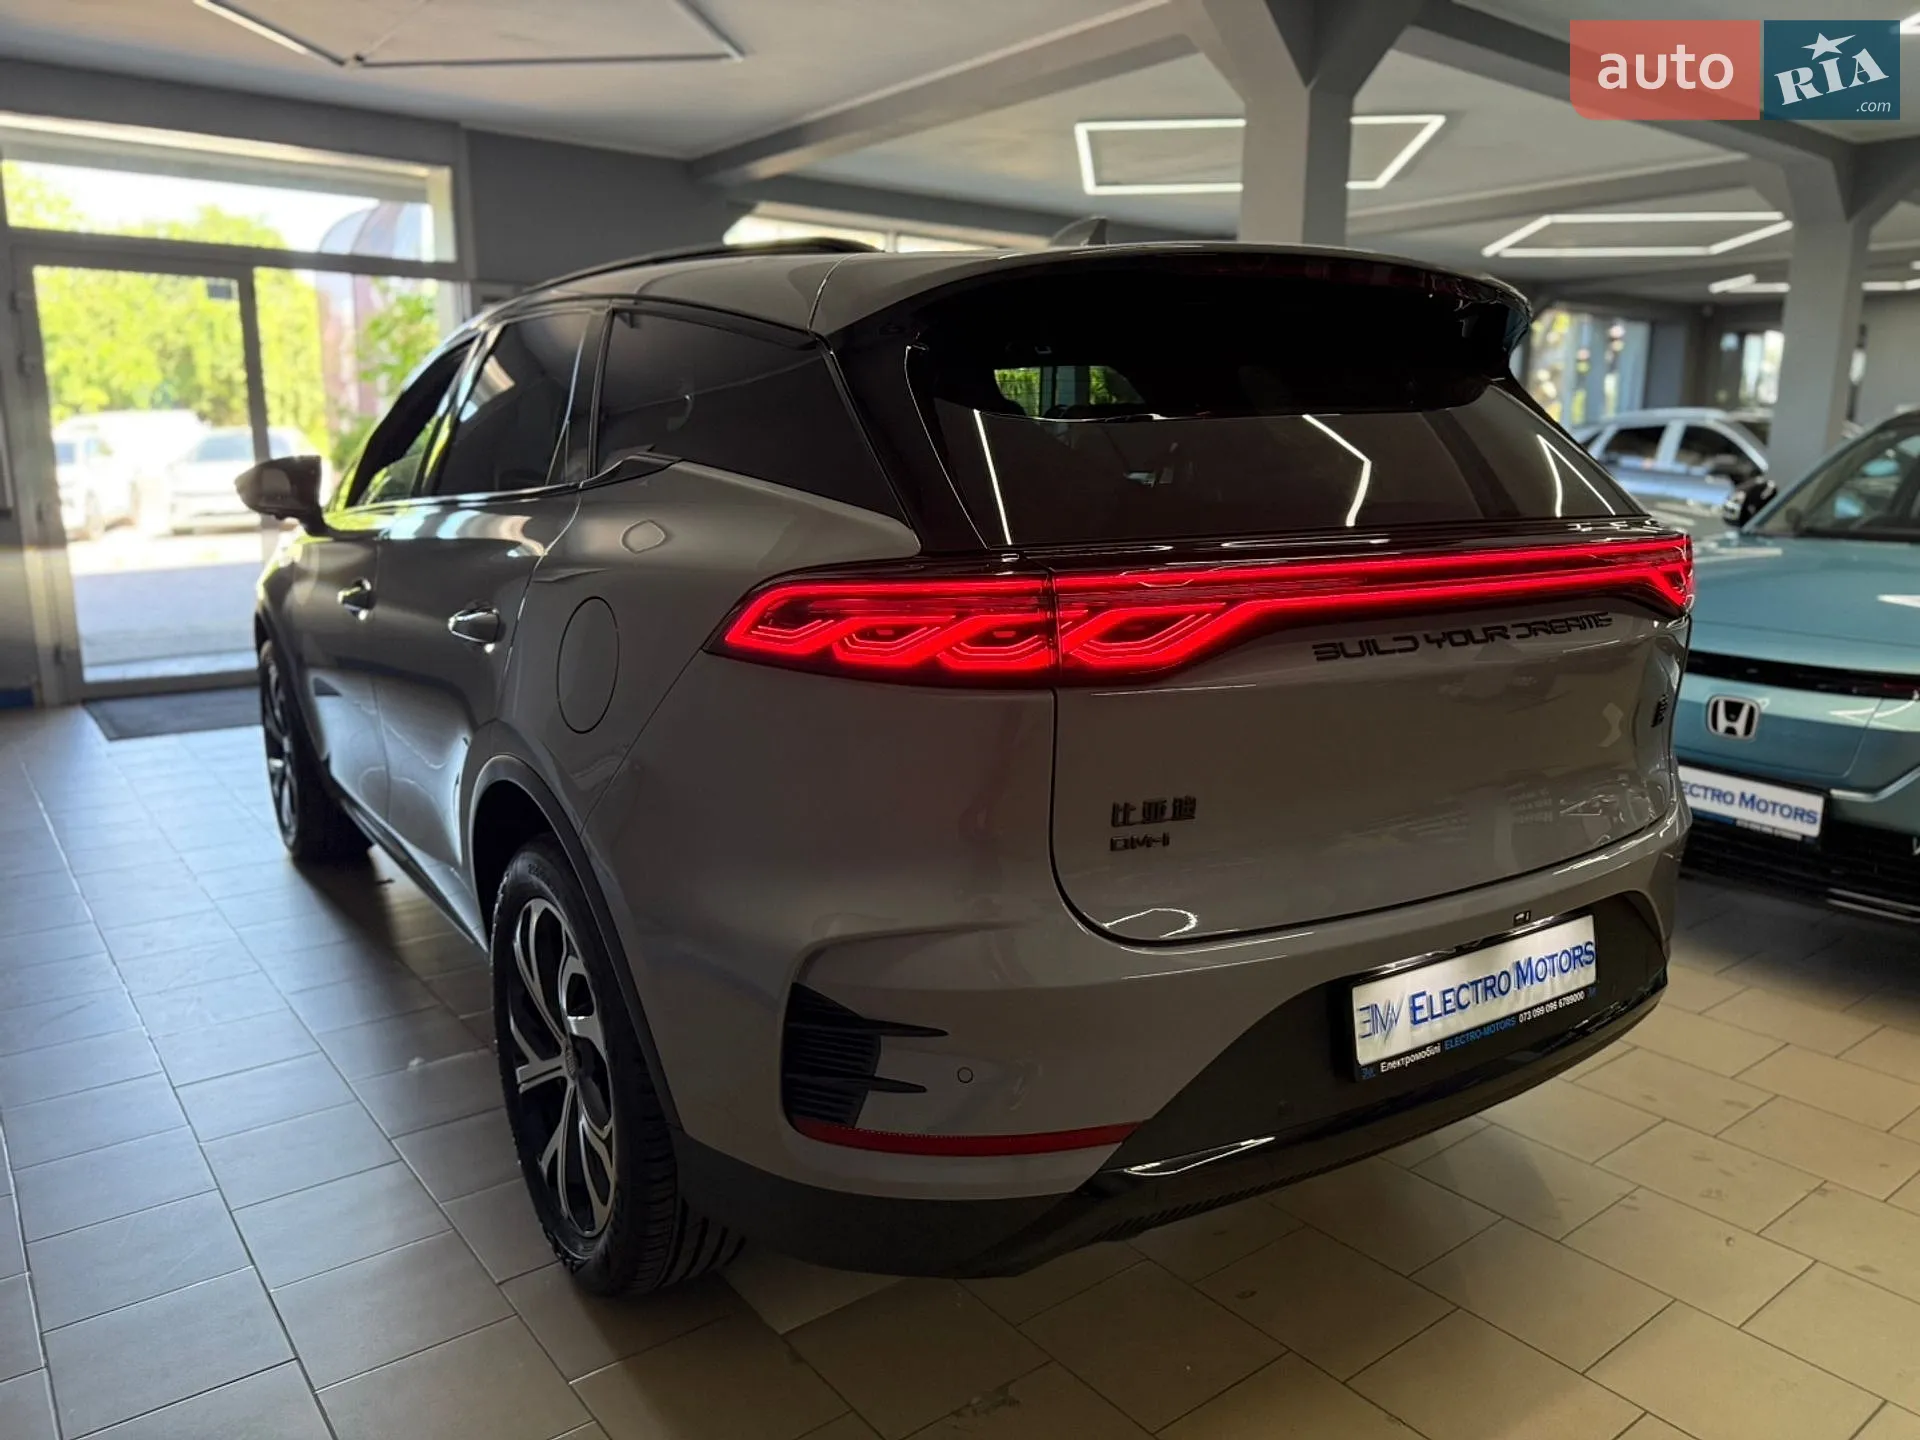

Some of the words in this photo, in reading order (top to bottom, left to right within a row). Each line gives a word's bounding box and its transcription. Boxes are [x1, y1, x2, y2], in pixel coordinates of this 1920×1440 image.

[1311, 635, 1420, 662] BUILD
[1423, 625, 1510, 649] YOUR
[1511, 611, 1613, 639] DREAMS
